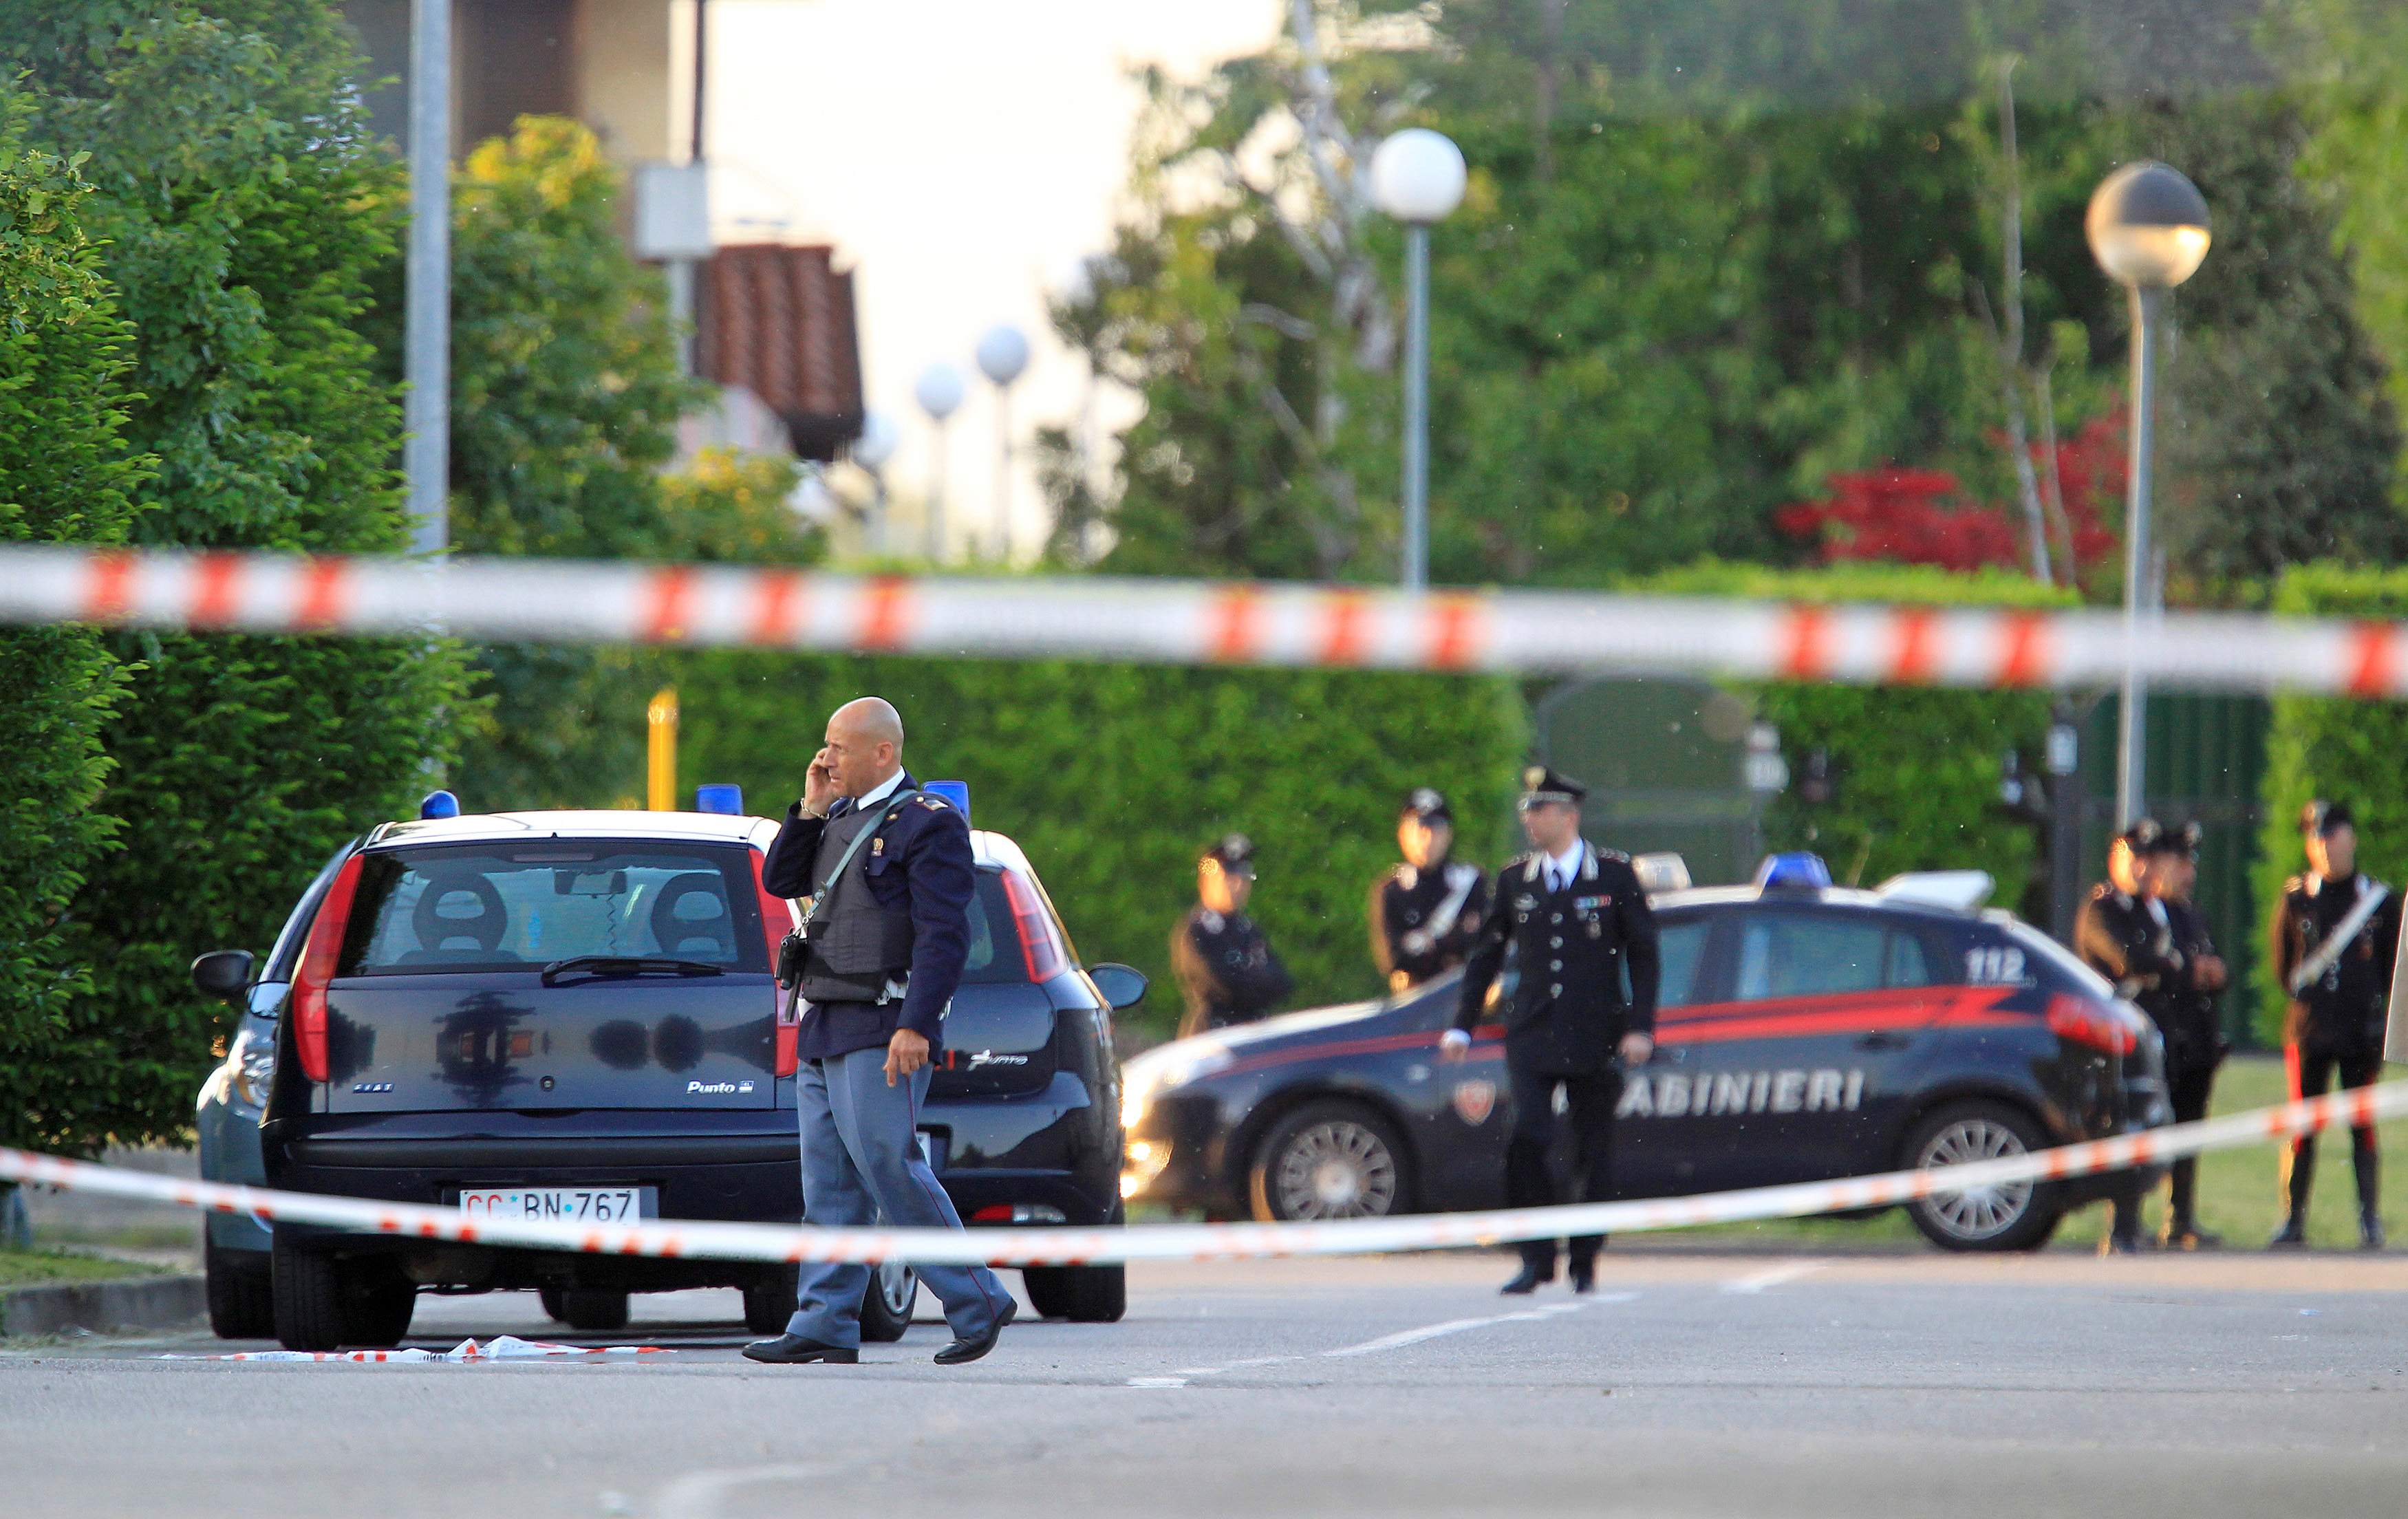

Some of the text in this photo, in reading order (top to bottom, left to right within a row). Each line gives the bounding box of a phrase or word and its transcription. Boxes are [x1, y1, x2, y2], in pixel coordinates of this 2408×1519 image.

[1967, 947, 2025, 981] 112
[353, 1083, 393, 1092] FIAT
[687, 1081, 735, 1094] Punto
[1614, 1068, 1864, 1119] ABINIERI
[468, 1194, 631, 1222] CC BN 767
